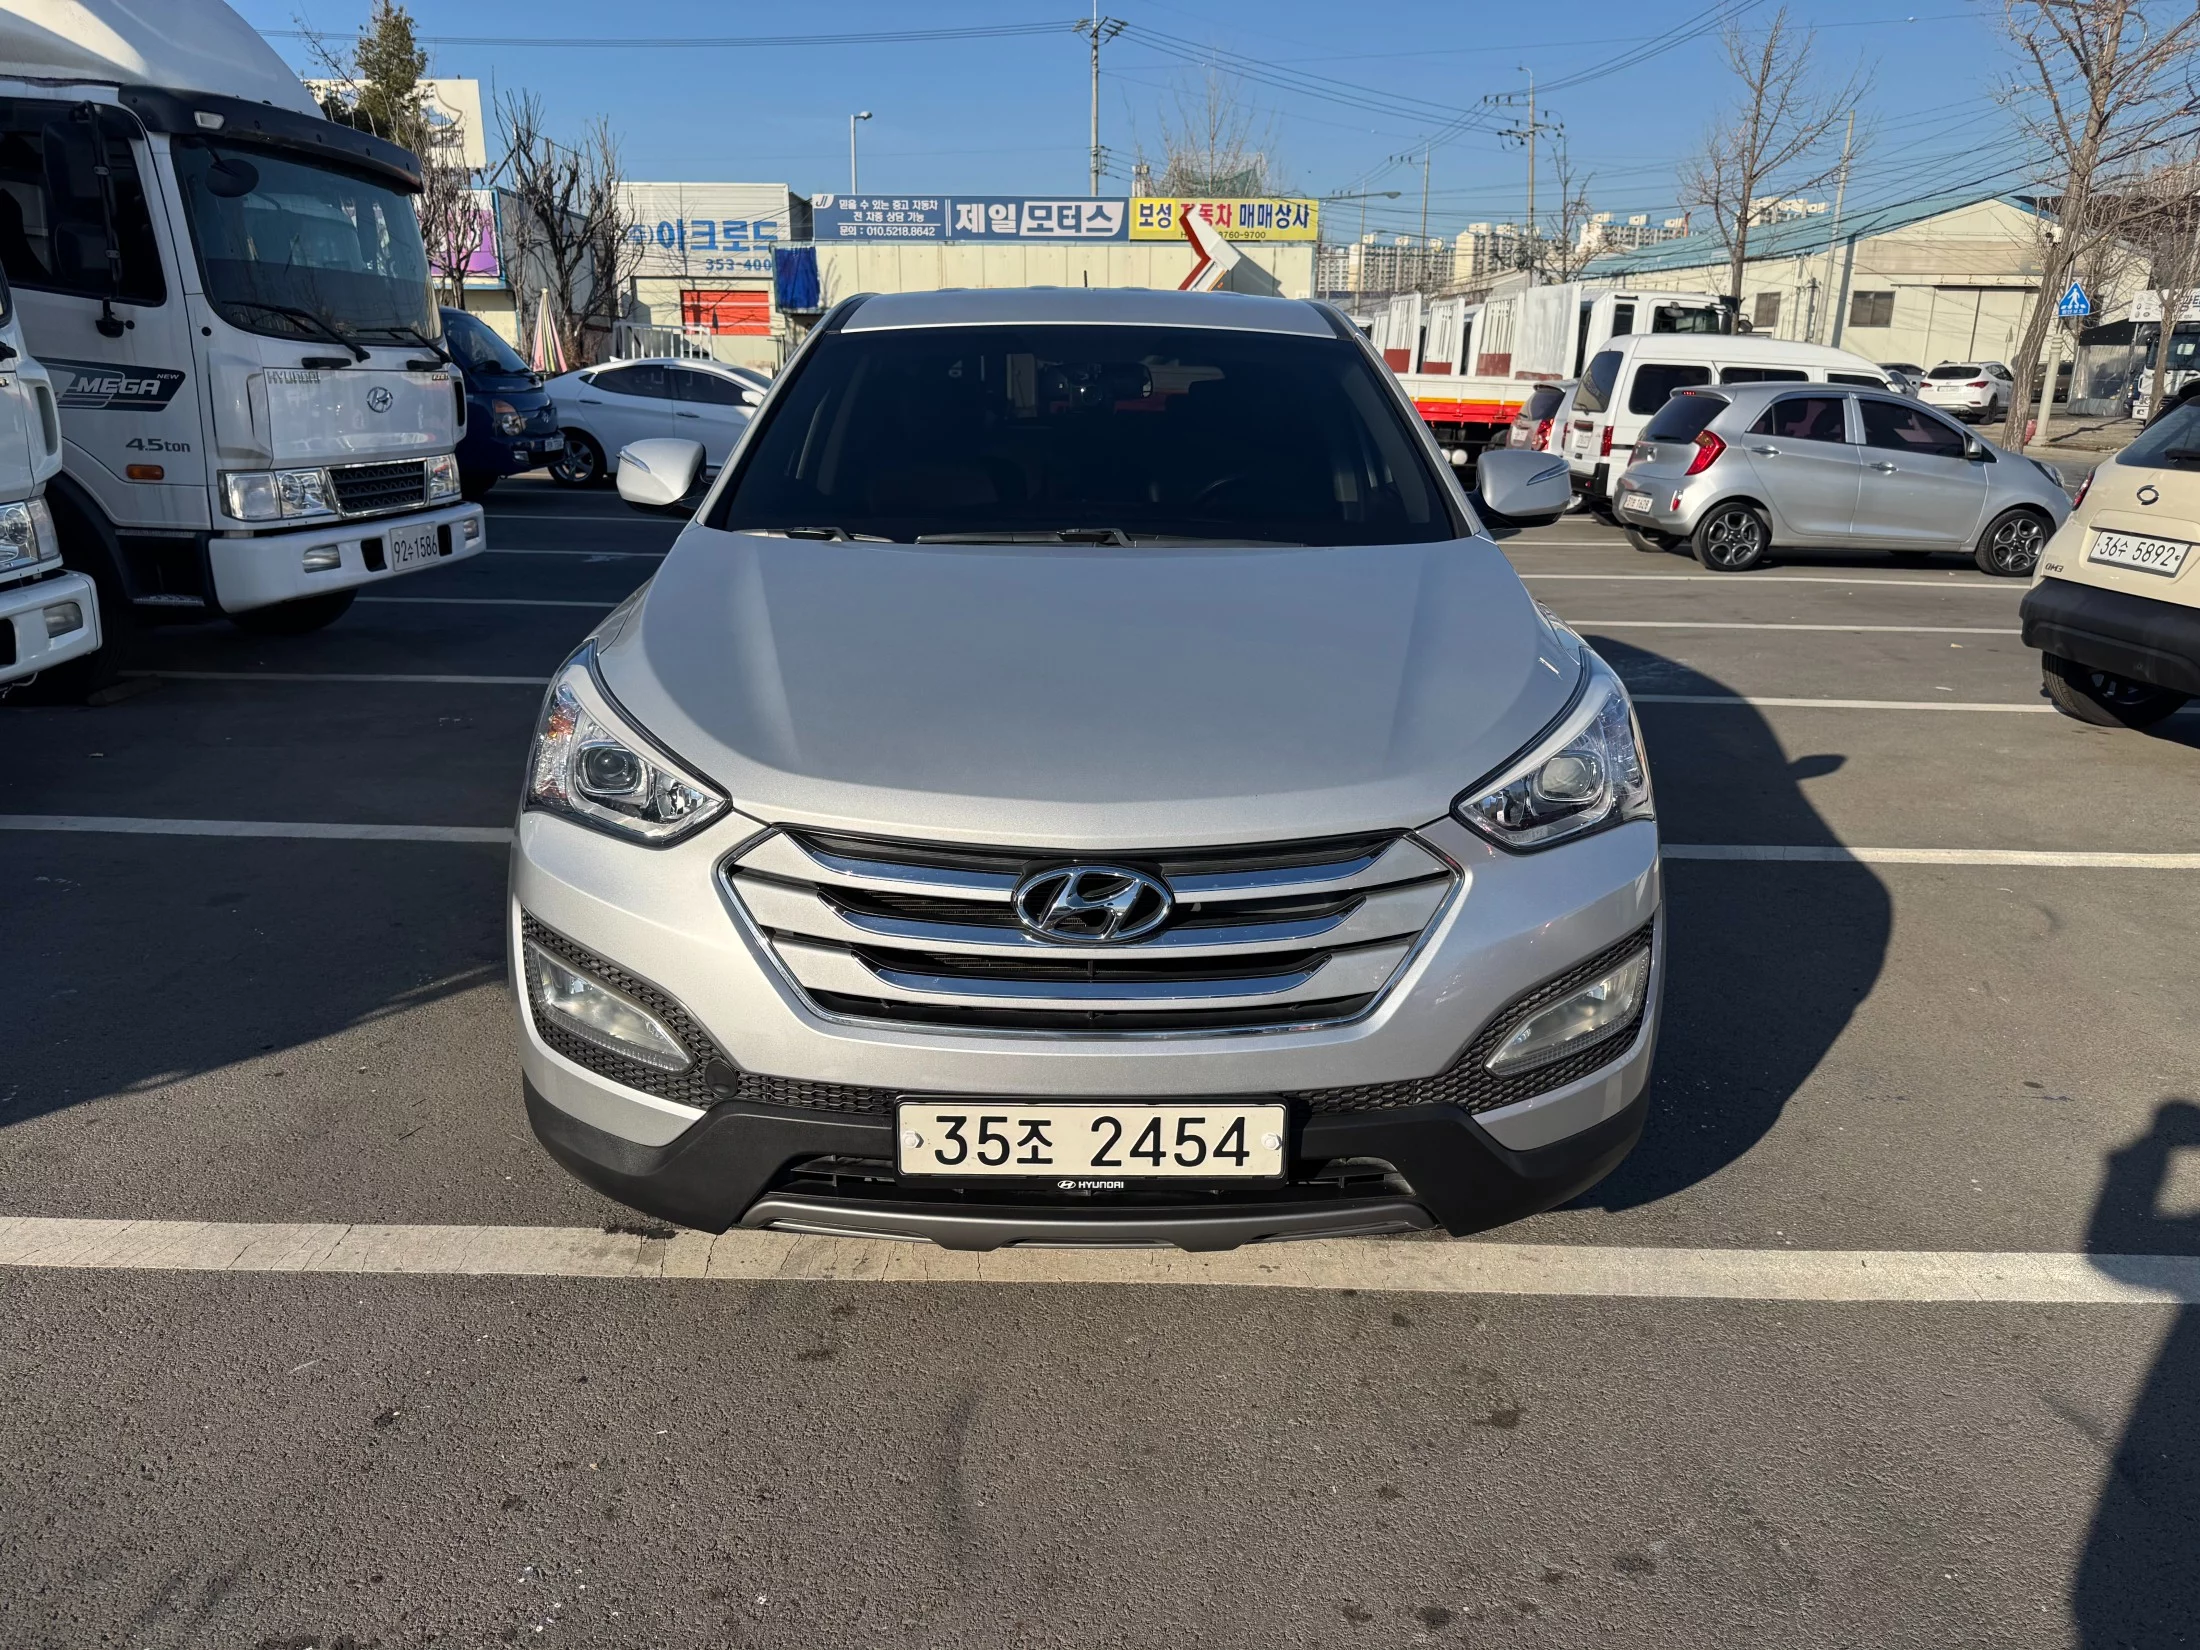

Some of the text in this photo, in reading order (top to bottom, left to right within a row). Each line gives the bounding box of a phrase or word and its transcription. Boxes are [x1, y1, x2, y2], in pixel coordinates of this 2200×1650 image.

[839, 199, 938, 210] 믿을 수 있는 중고 자동차
[853, 212, 924, 222] 전 차종 상담 가능
[1138, 203, 1172, 229] 보성
[1239, 203, 1310, 229] 매매상사
[840, 226, 857, 236] 문의
[866, 226, 936, 237] 010.5218.8642
[266, 370, 321, 384] HYUNDAI
[76, 377, 161, 395] MEGA
[2099, 536, 2176, 566] 36수 5892
[934, 1115, 1251, 1168] 35조 2454
[1078, 1181, 1125, 1189] HYUNDAI
